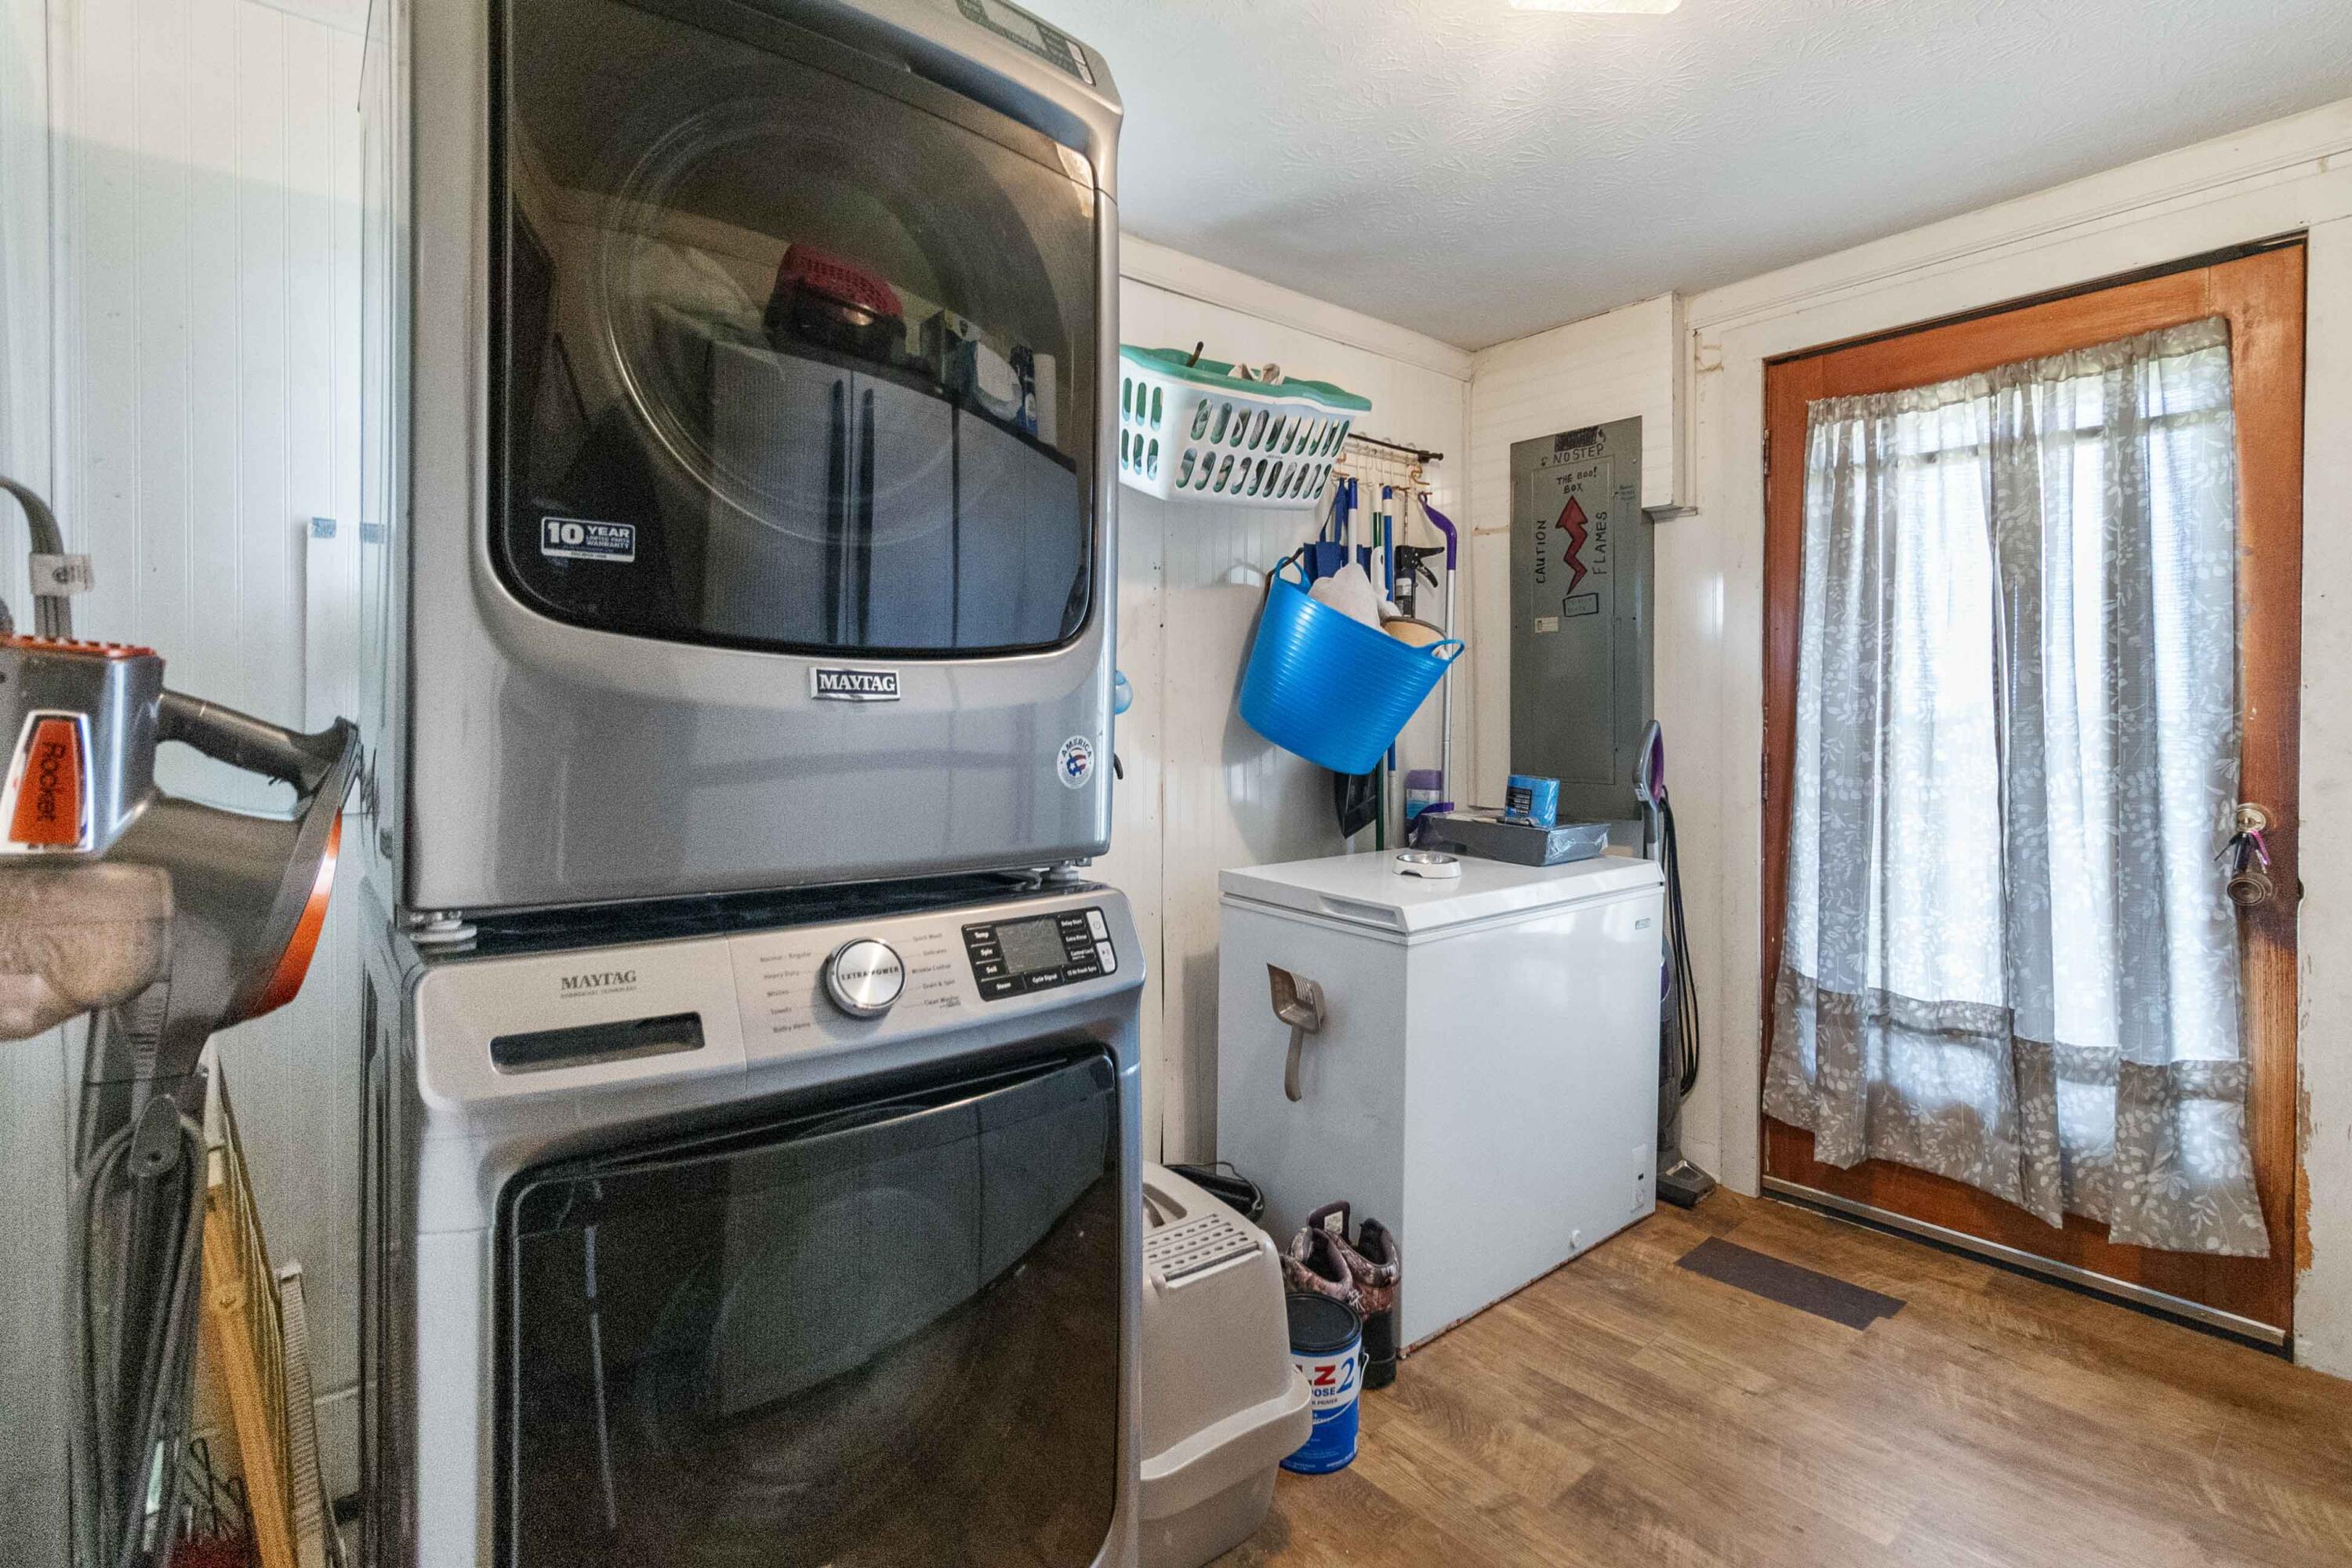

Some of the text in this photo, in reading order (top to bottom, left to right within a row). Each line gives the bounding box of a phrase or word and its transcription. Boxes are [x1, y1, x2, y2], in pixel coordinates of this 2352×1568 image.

[1573, 443, 1604, 460] STEP
[1556, 474, 1573, 485] THE
[1564, 483, 1584, 495] BOX
[548, 521, 630, 545] 10 YEAR
[1592, 511, 1608, 575] FLAMES
[1535, 520, 1547, 584] CAUTION
[818, 673, 896, 691] MAYTAG
[1062, 738, 1092, 757] AMERICA
[980, 948, 993, 956] Spin
[841, 966, 899, 981] EXTRA POWER
[986, 965, 998, 974] Soil
[1044, 973, 1058, 982] Signal
[561, 970, 637, 989] MAYTAG
[1337, 1357, 1355, 1394] 2
[1312, 1387, 1337, 1397] OSE
